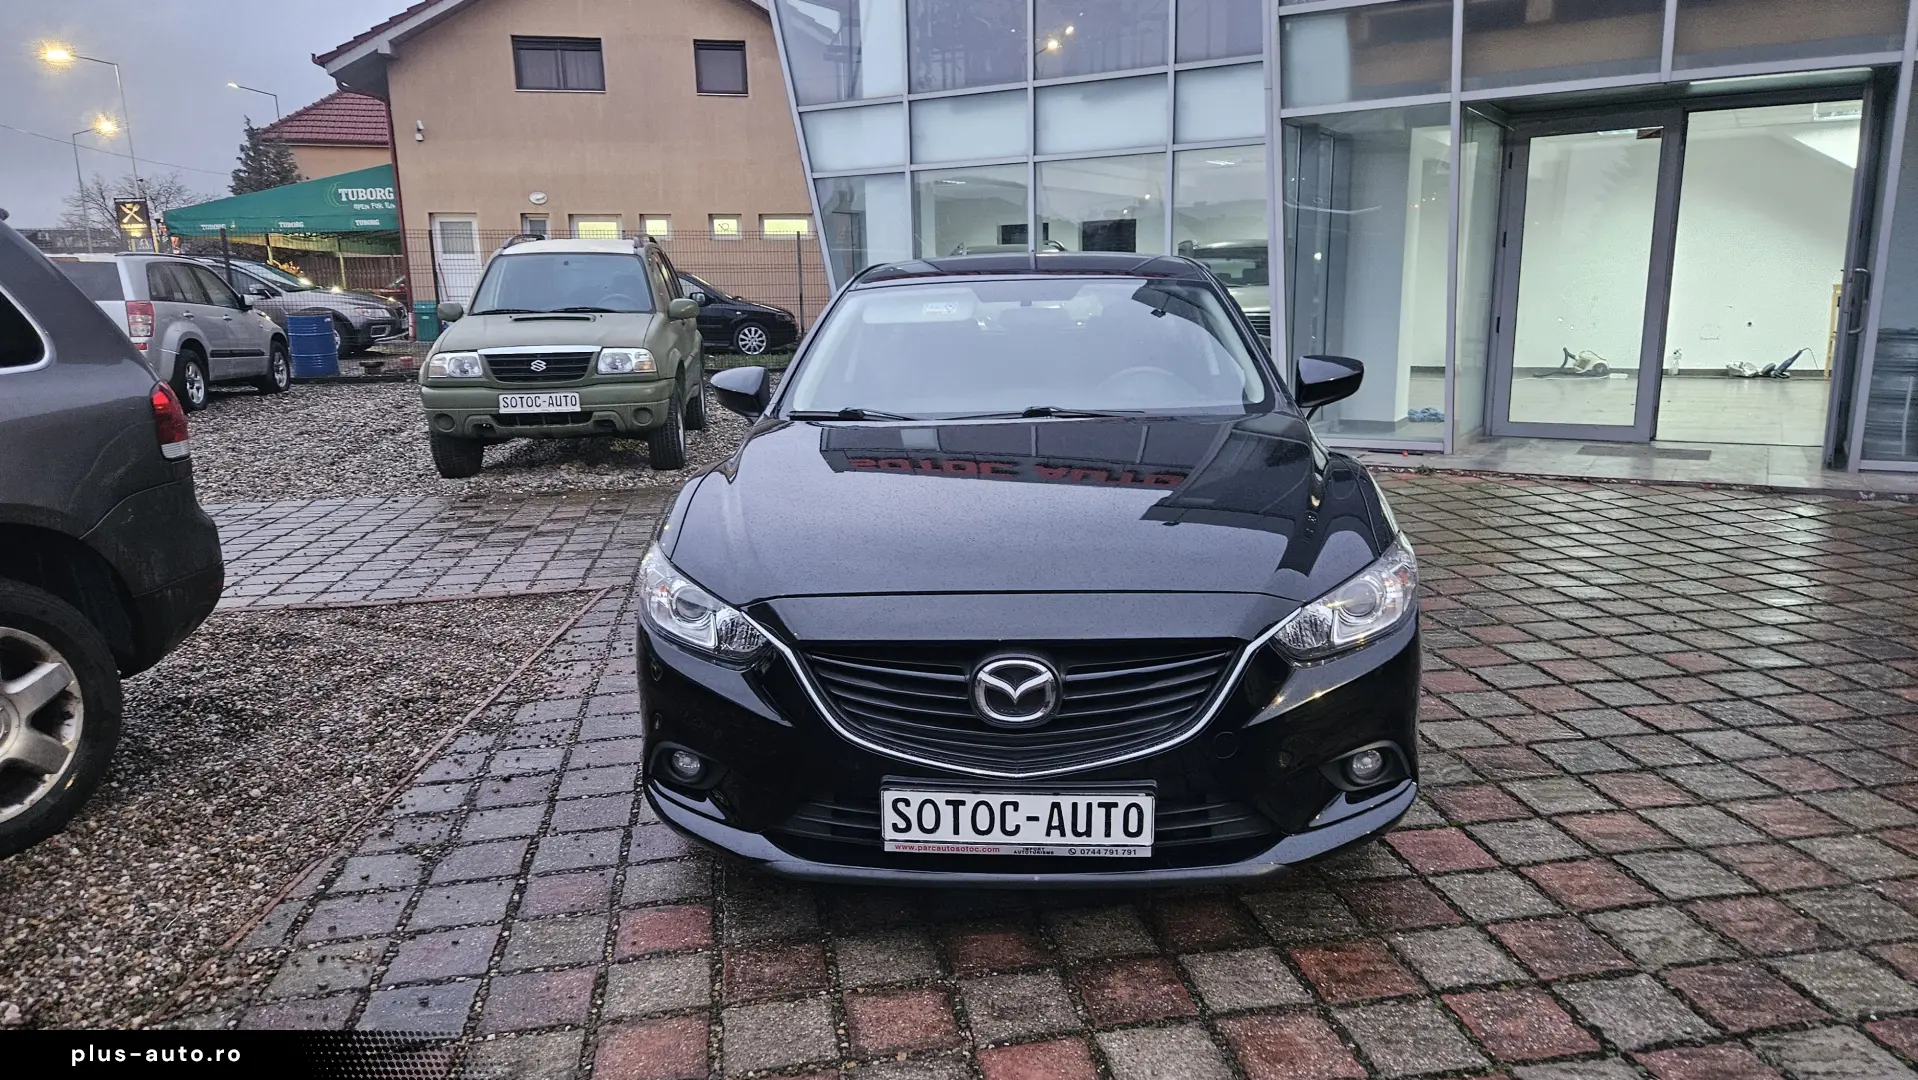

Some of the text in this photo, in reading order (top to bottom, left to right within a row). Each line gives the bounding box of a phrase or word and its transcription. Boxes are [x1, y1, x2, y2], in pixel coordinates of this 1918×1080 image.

[338, 187, 394, 201] TUBORG
[502, 395, 577, 408] SOTOC-AUTO
[891, 797, 1144, 838] SOTOC-AUTO
[895, 843, 1000, 853] www.parcautosotoc.com
